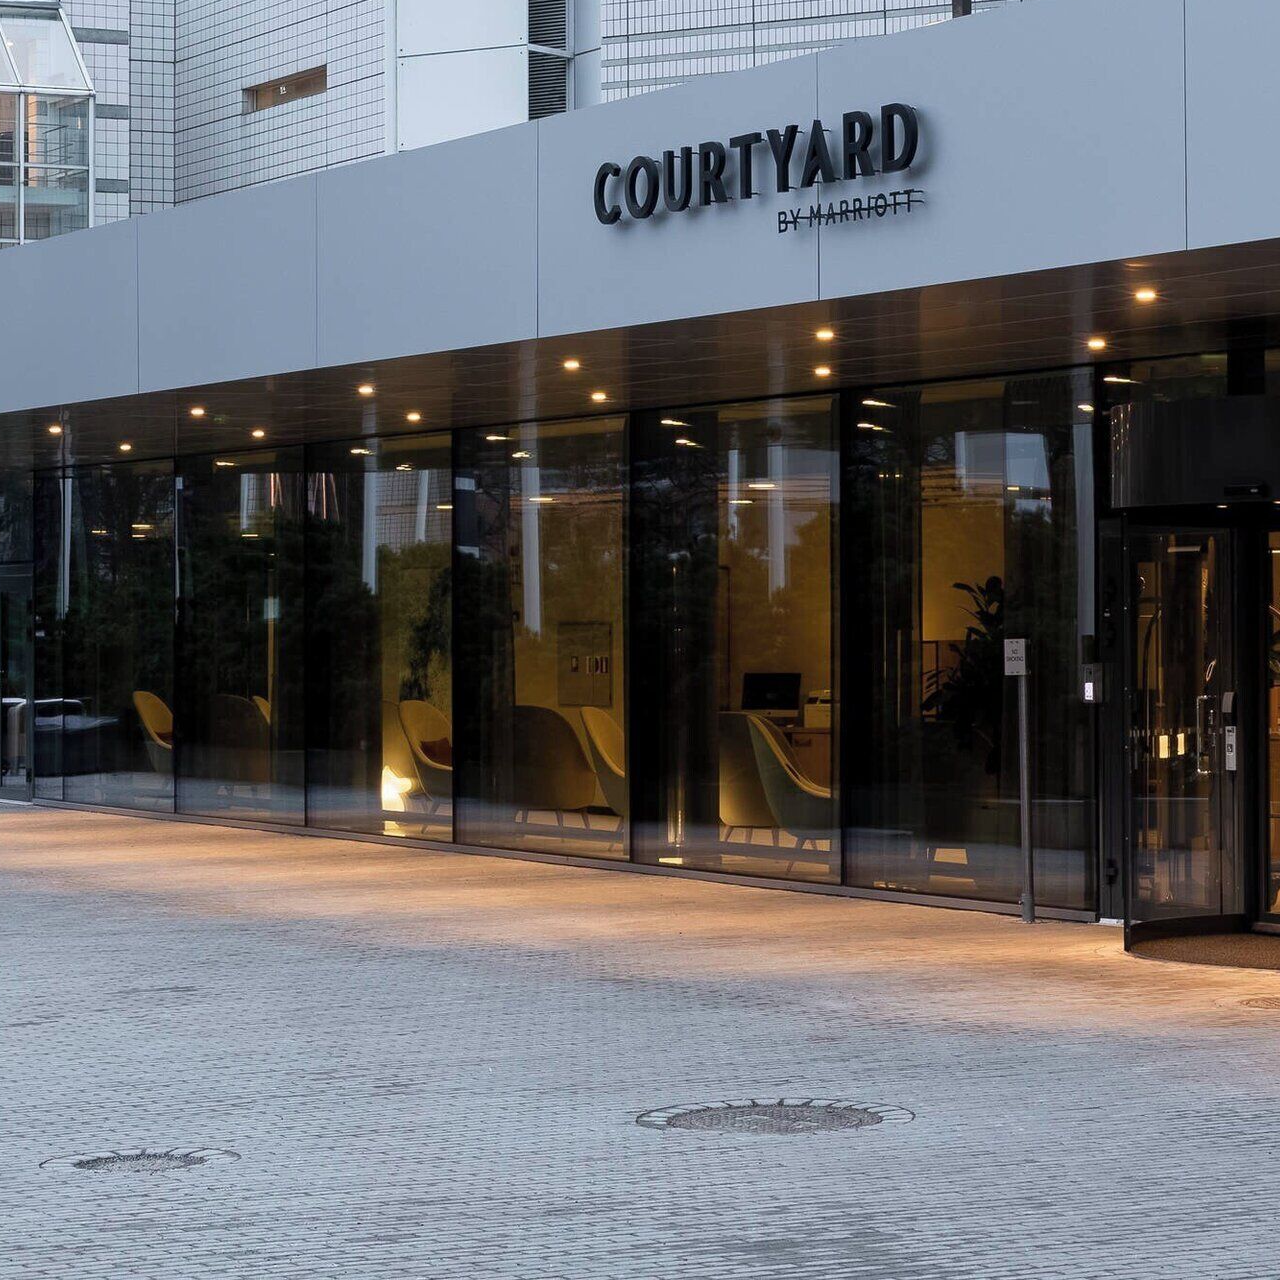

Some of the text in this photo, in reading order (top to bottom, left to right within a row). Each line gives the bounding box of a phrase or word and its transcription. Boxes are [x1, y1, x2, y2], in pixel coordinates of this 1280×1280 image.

[594, 103, 919, 224] COURTYARD
[777, 188, 915, 234] BY MARRIOTT
